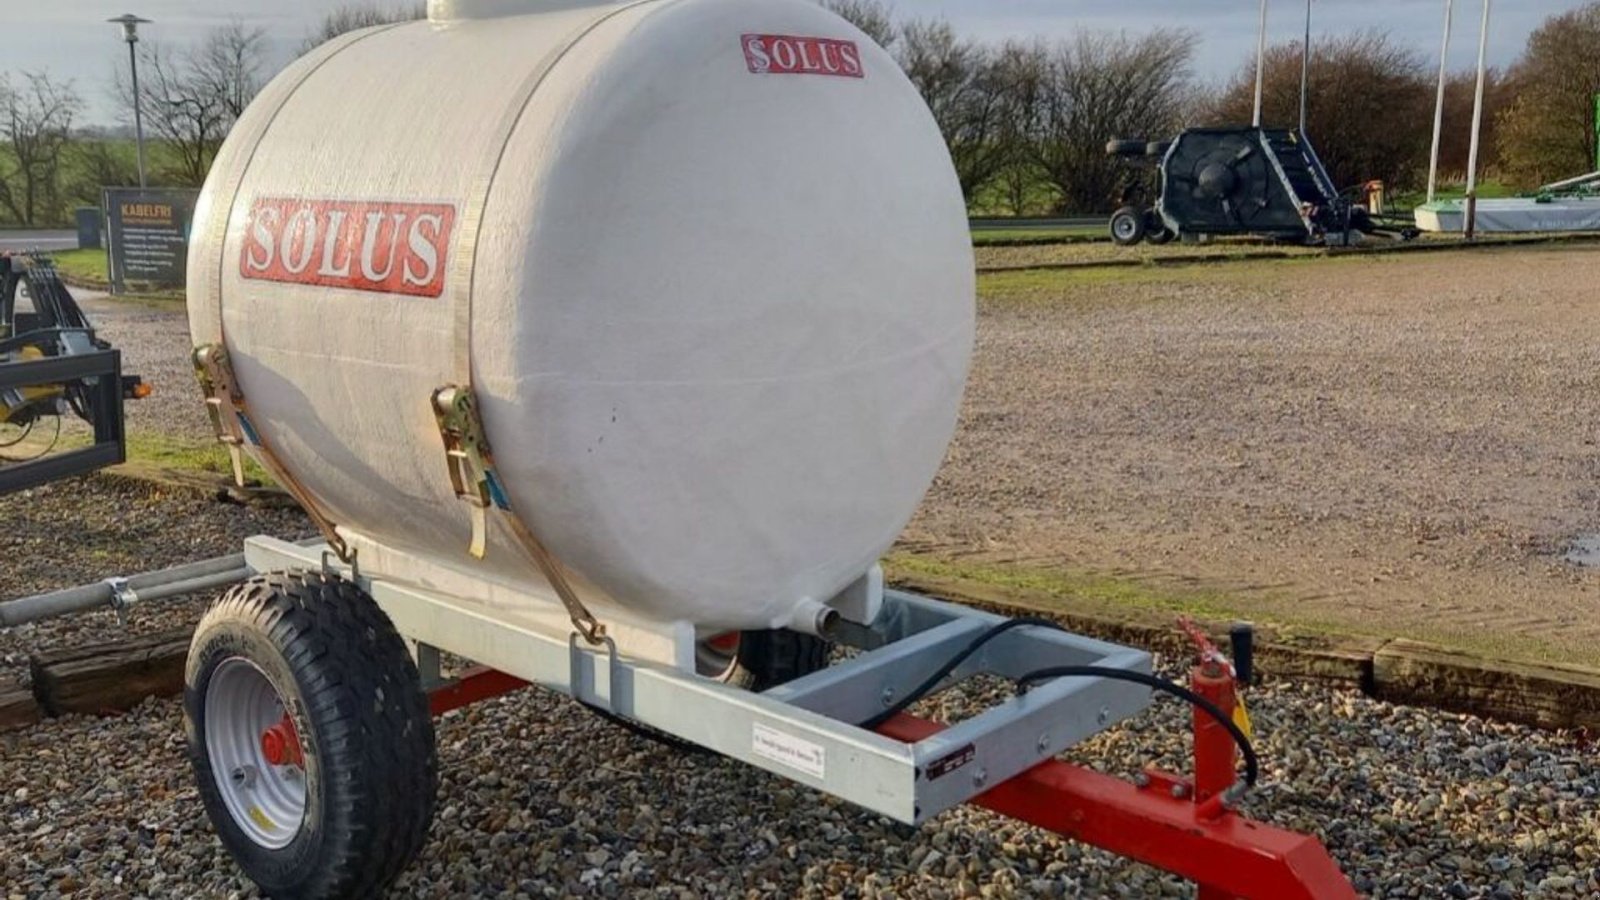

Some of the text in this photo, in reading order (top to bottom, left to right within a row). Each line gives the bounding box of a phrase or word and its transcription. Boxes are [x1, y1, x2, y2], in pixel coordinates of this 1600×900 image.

[748, 39, 859, 74] SOLUS
[122, 204, 172, 217] KABELFRI
[246, 206, 443, 287] SOLUS
